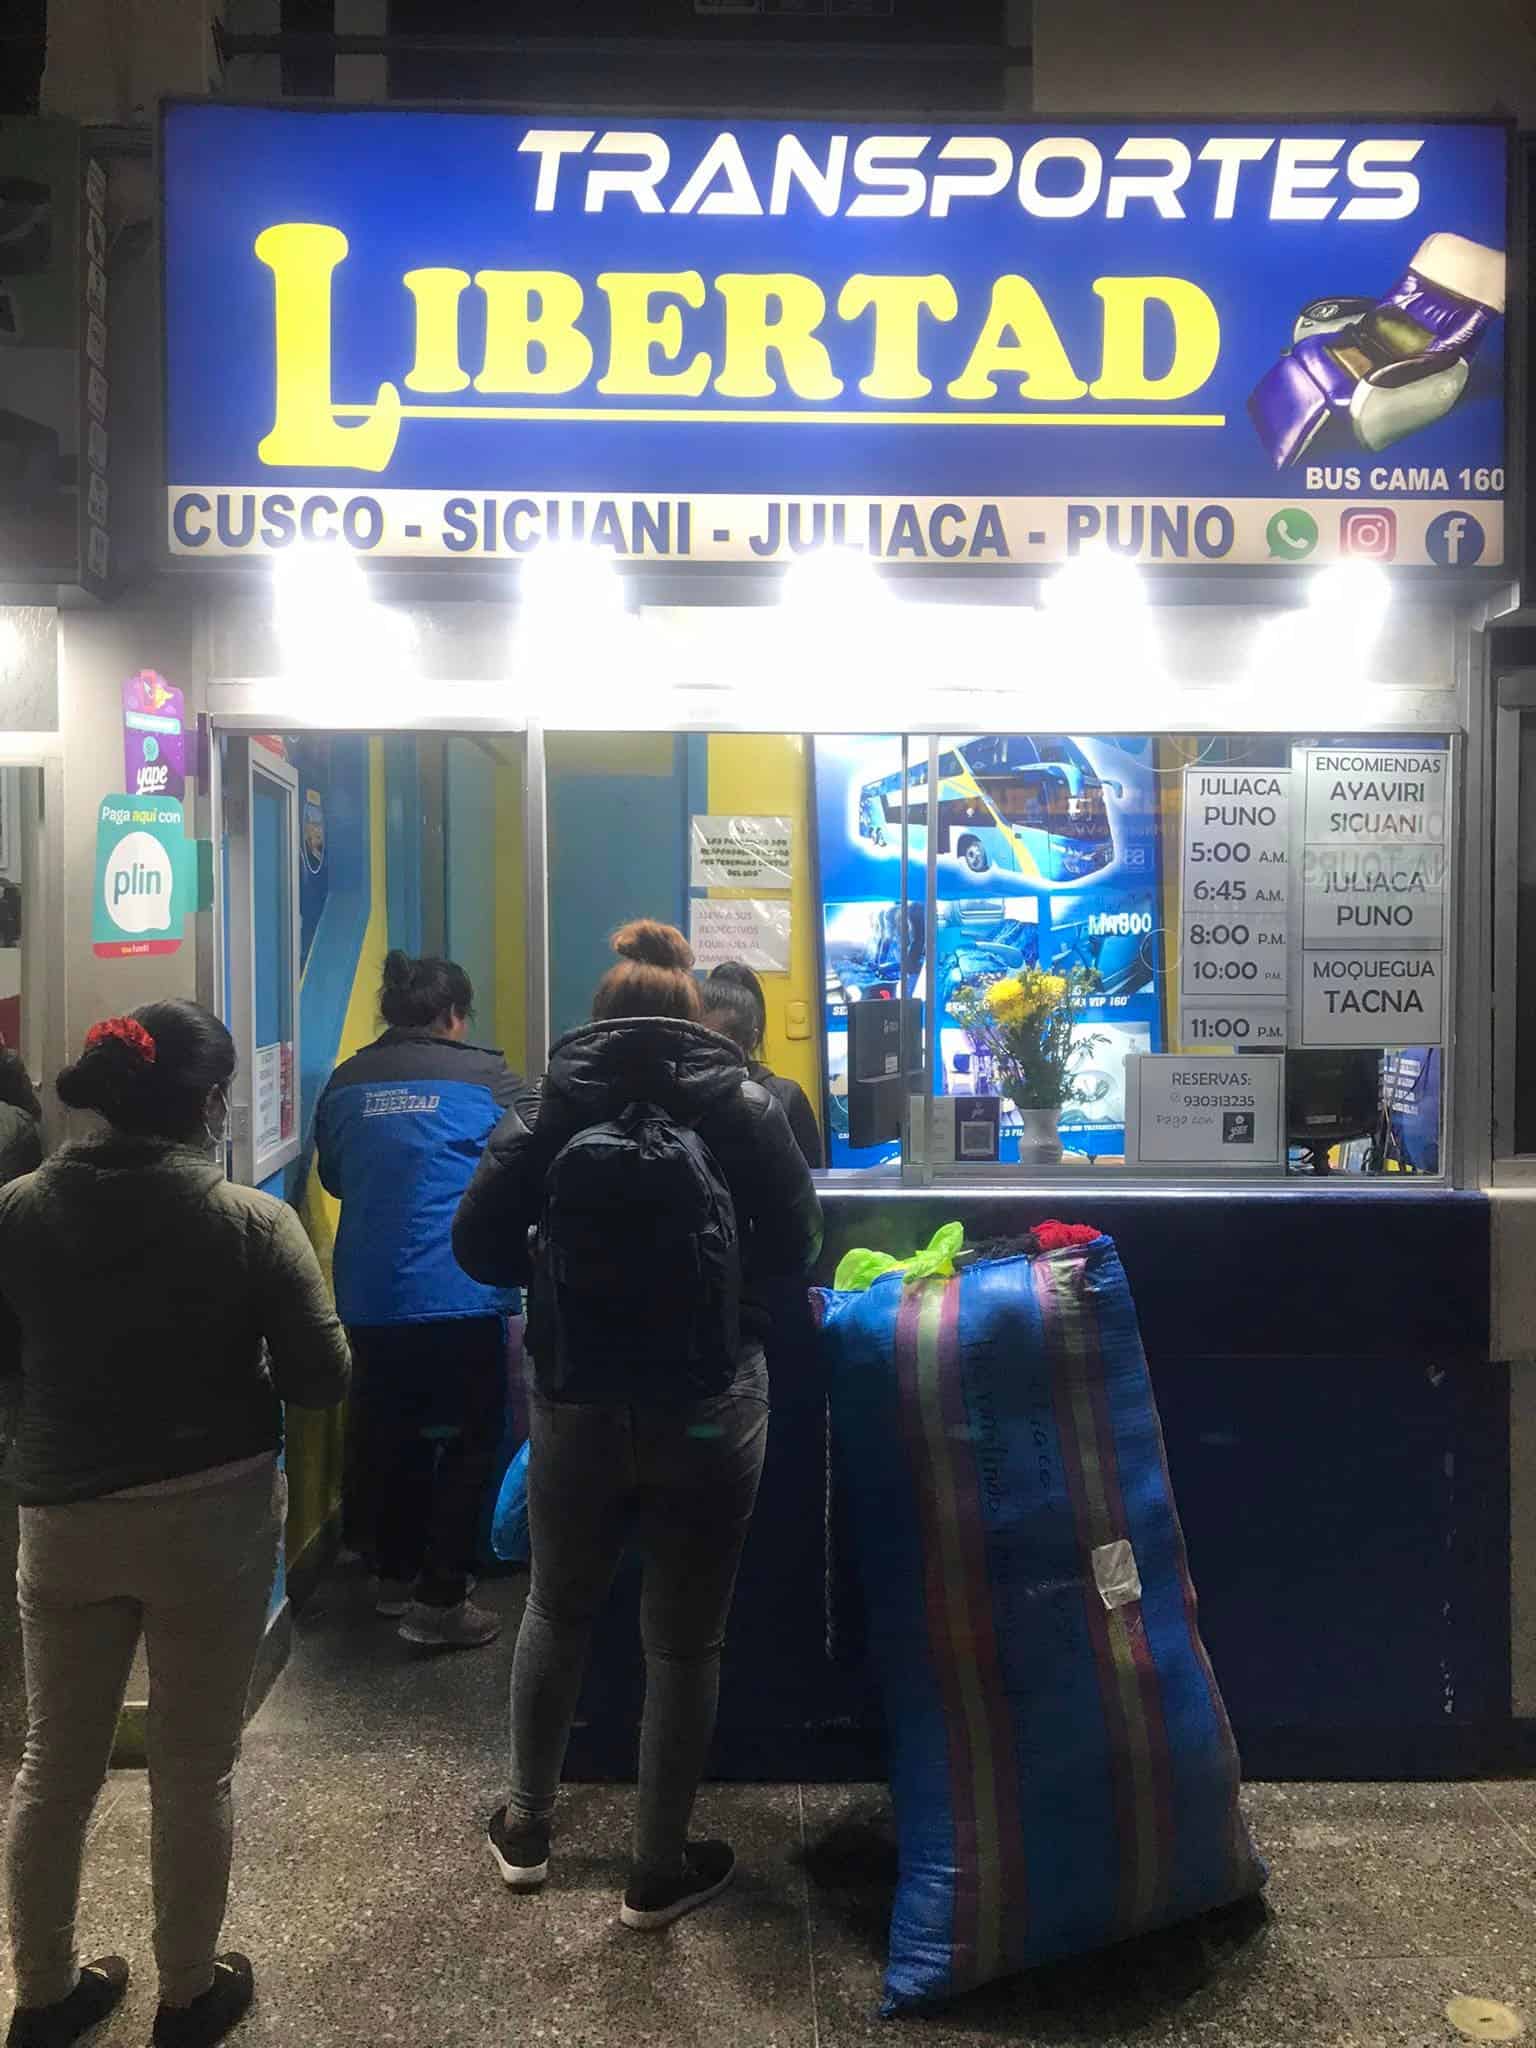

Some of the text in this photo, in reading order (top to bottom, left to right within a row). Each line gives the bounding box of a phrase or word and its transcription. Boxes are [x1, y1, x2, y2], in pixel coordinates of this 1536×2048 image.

[517, 130, 1424, 220] TRANSPORTES
[255, 223, 1220, 472] LIBERTAD
[1306, 467, 1361, 490] BUS
[1370, 467, 1449, 490] CAMA
[173, 493, 384, 550] CUSCO
[443, 498, 690, 554] SICUANI
[749, 503, 1010, 557] JULIACA
[1067, 504, 1235, 558] PUNO
[1316, 757, 1441, 773] ENCOMIENDAS
[136, 765, 168, 795] yape
[1200, 778, 1281, 796] JULIACA
[1330, 782, 1424, 801] AYAVIRI
[101, 806, 131, 824] Paga
[158, 812, 181, 823] con
[1204, 806, 1276, 826] PUNO
[1330, 813, 1423, 833] SICUANI
[1190, 842, 1251, 862] 5:00
[113, 863, 162, 905] plin
[1193, 881, 1247, 901] 6:45
[1324, 871, 1426, 893] JULIACA
[1336, 905, 1413, 926] PUNO
[1190, 925, 1249, 945] 8:00
[1192, 961, 1258, 980] 10:00
[1313, 961, 1435, 980] MOQUEGUA
[1324, 990, 1424, 1013] TACNA
[1190, 1019, 1250, 1039] 11:00
[1172, 1073, 1253, 1088] RESERVAS:
[1183, 1095, 1256, 1108] 930313235
